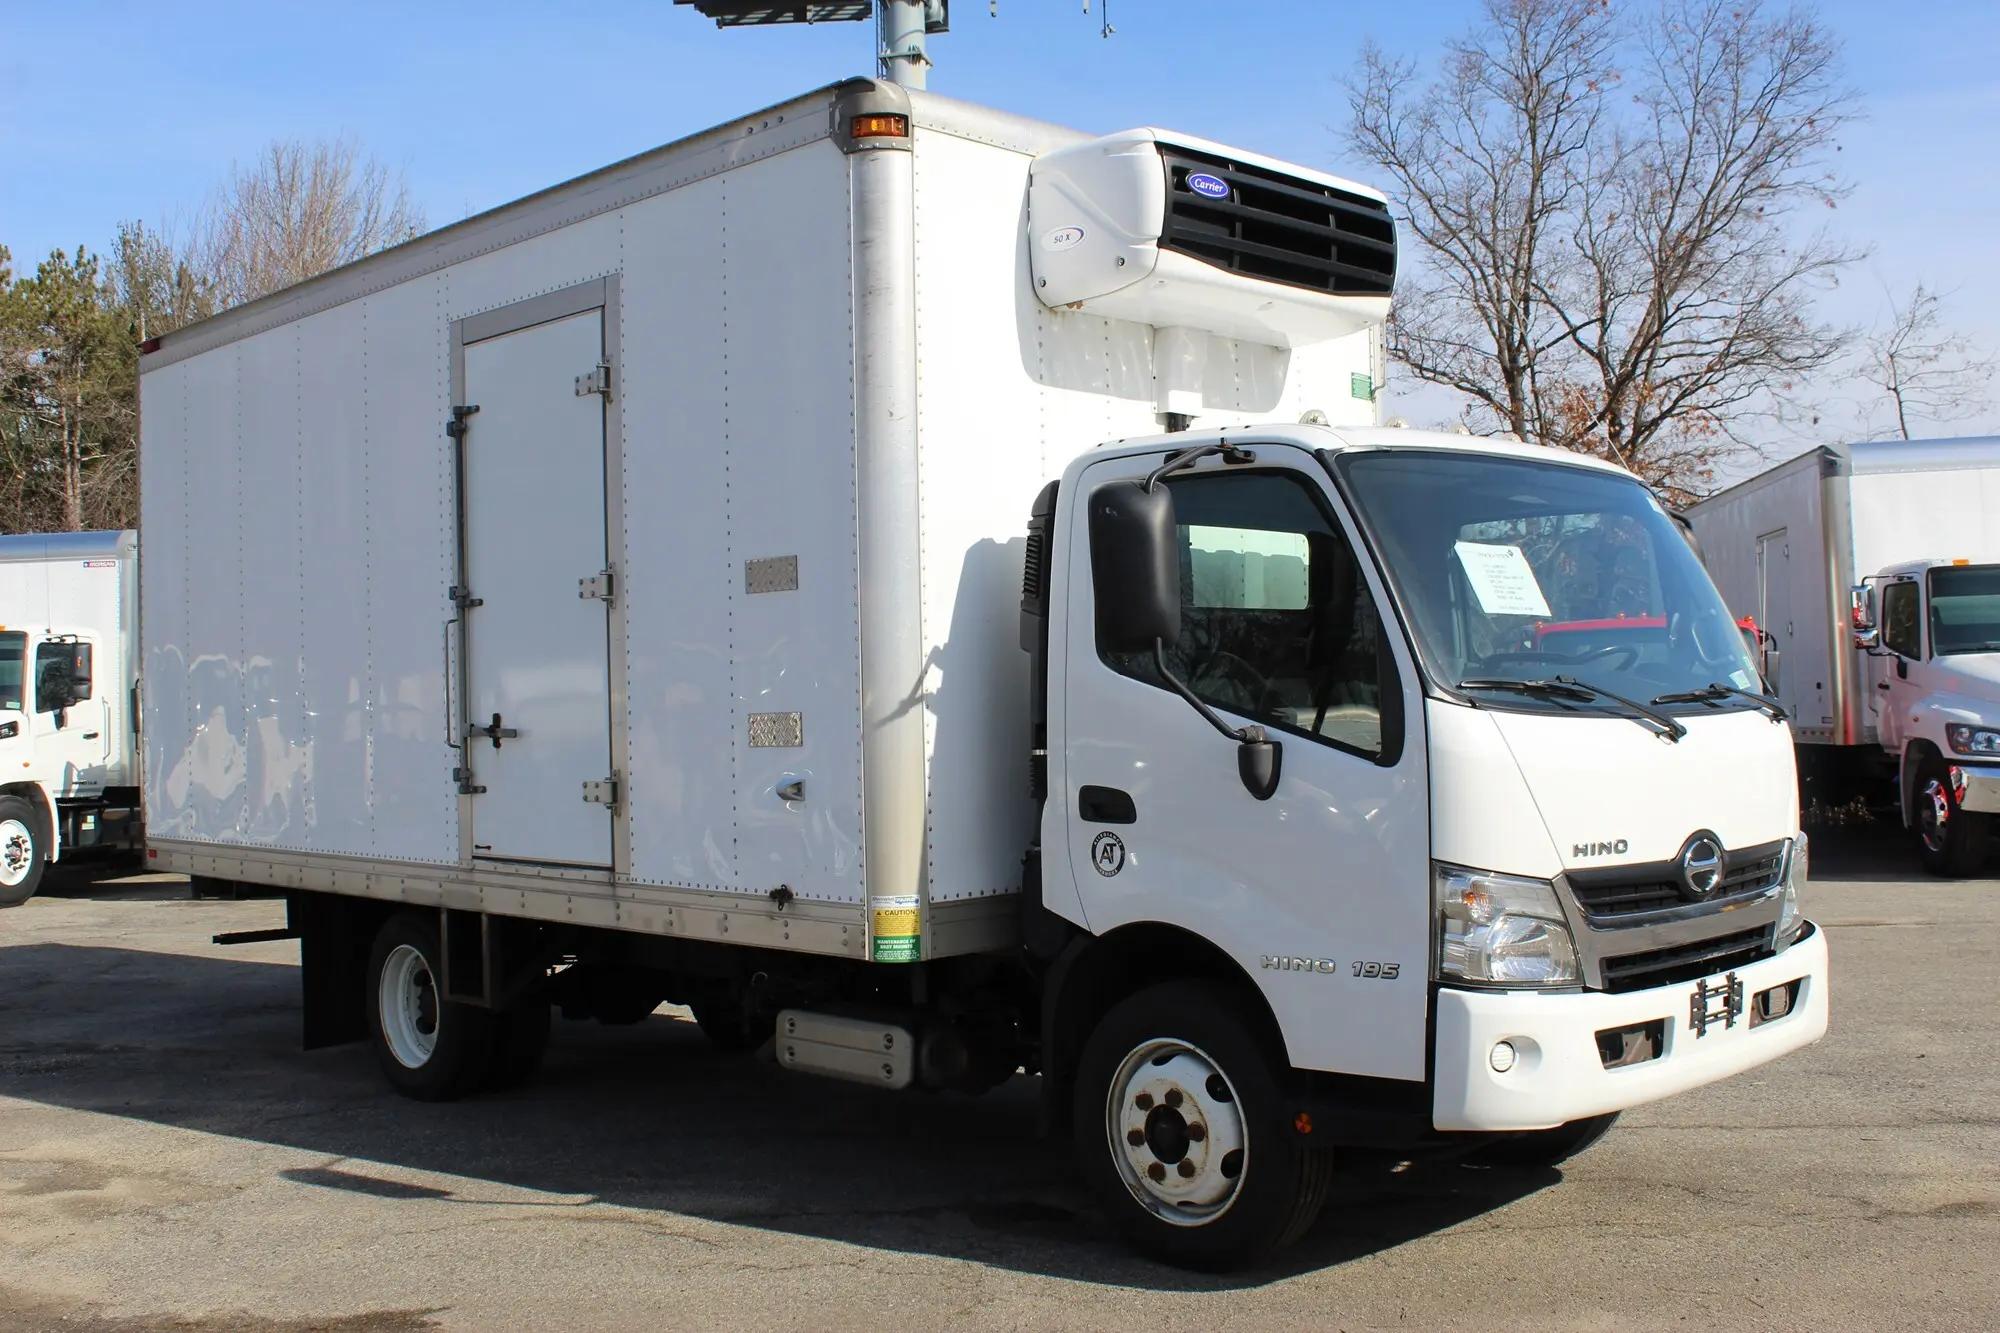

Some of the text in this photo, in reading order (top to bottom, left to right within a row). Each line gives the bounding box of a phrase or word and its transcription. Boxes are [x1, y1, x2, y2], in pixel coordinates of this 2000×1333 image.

[1194, 178, 1224, 192] Carrier
[1099, 843, 1117, 864] AT
[1572, 838, 1629, 858] HINO
[1260, 955, 1400, 980] HINO 195
